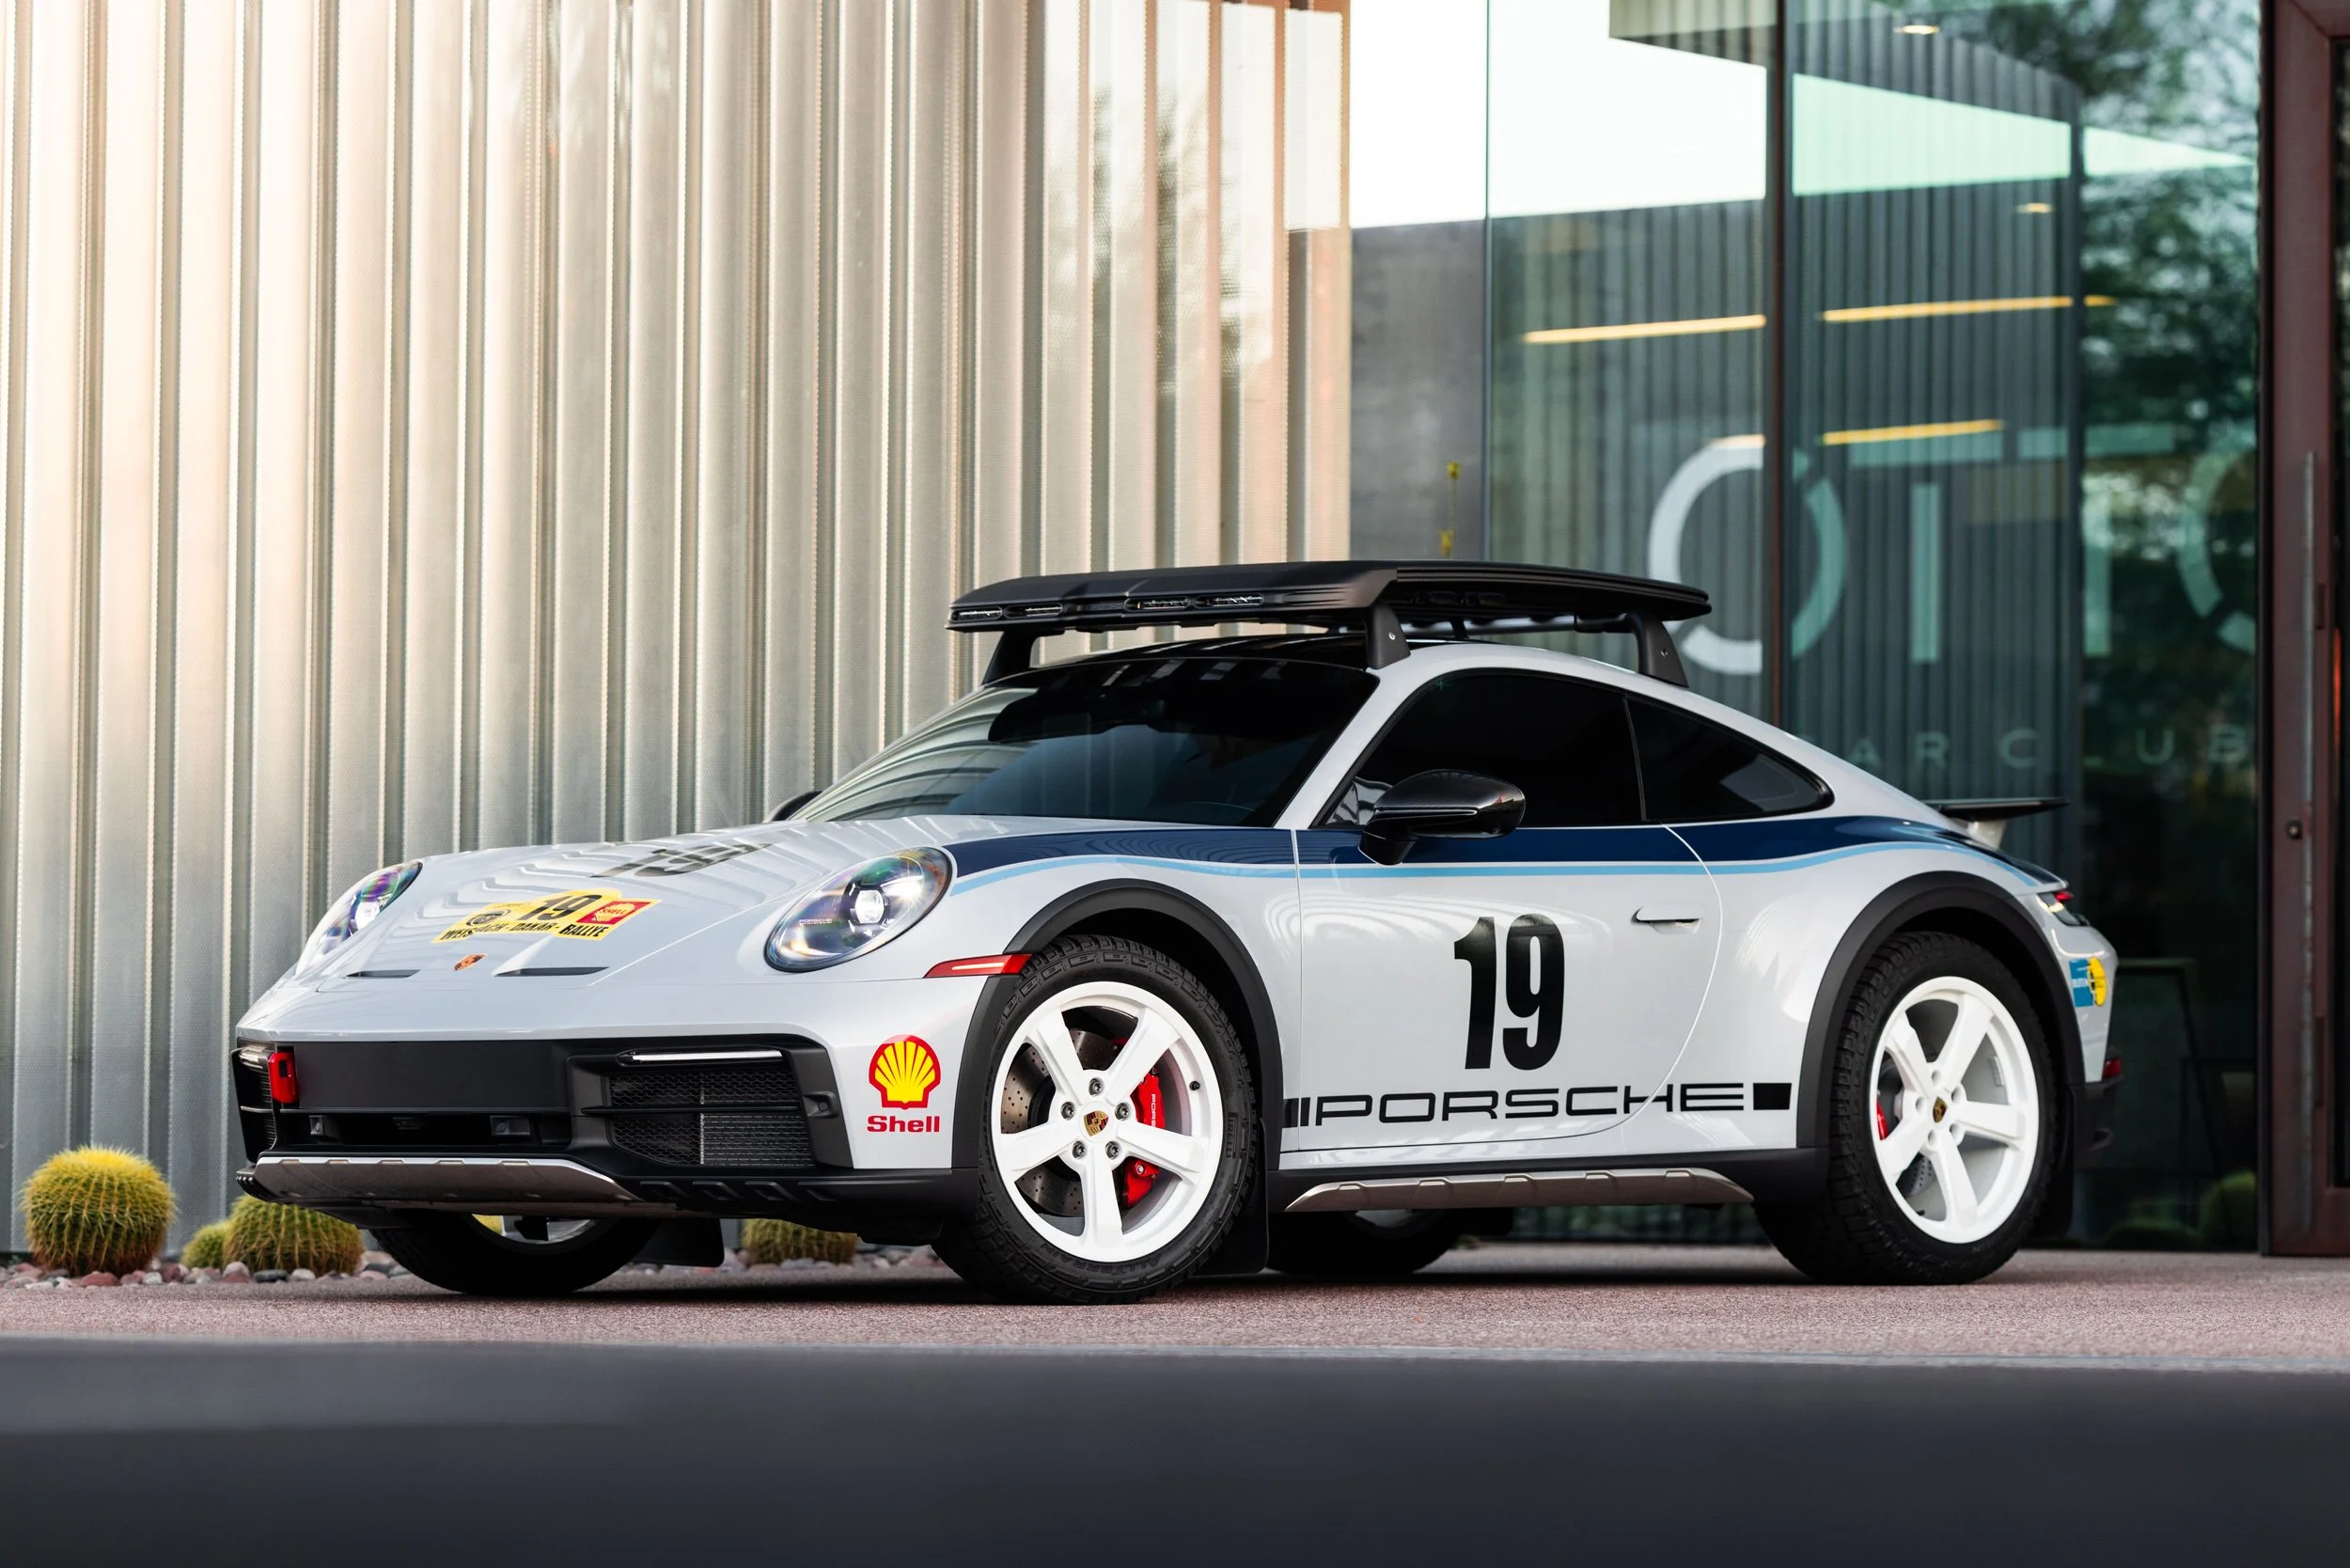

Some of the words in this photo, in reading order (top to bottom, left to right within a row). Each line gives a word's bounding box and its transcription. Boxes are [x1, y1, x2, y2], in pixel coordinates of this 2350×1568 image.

[1797, 730, 1949, 772] AR
[517, 894, 603, 920] 19
[509, 922, 558, 932] DAKAR
[558, 924, 609, 937] RALLYE
[1453, 913, 1565, 1071] 19
[1315, 1083, 1744, 1126] PORSCHE
[867, 1115, 940, 1133] Shell
